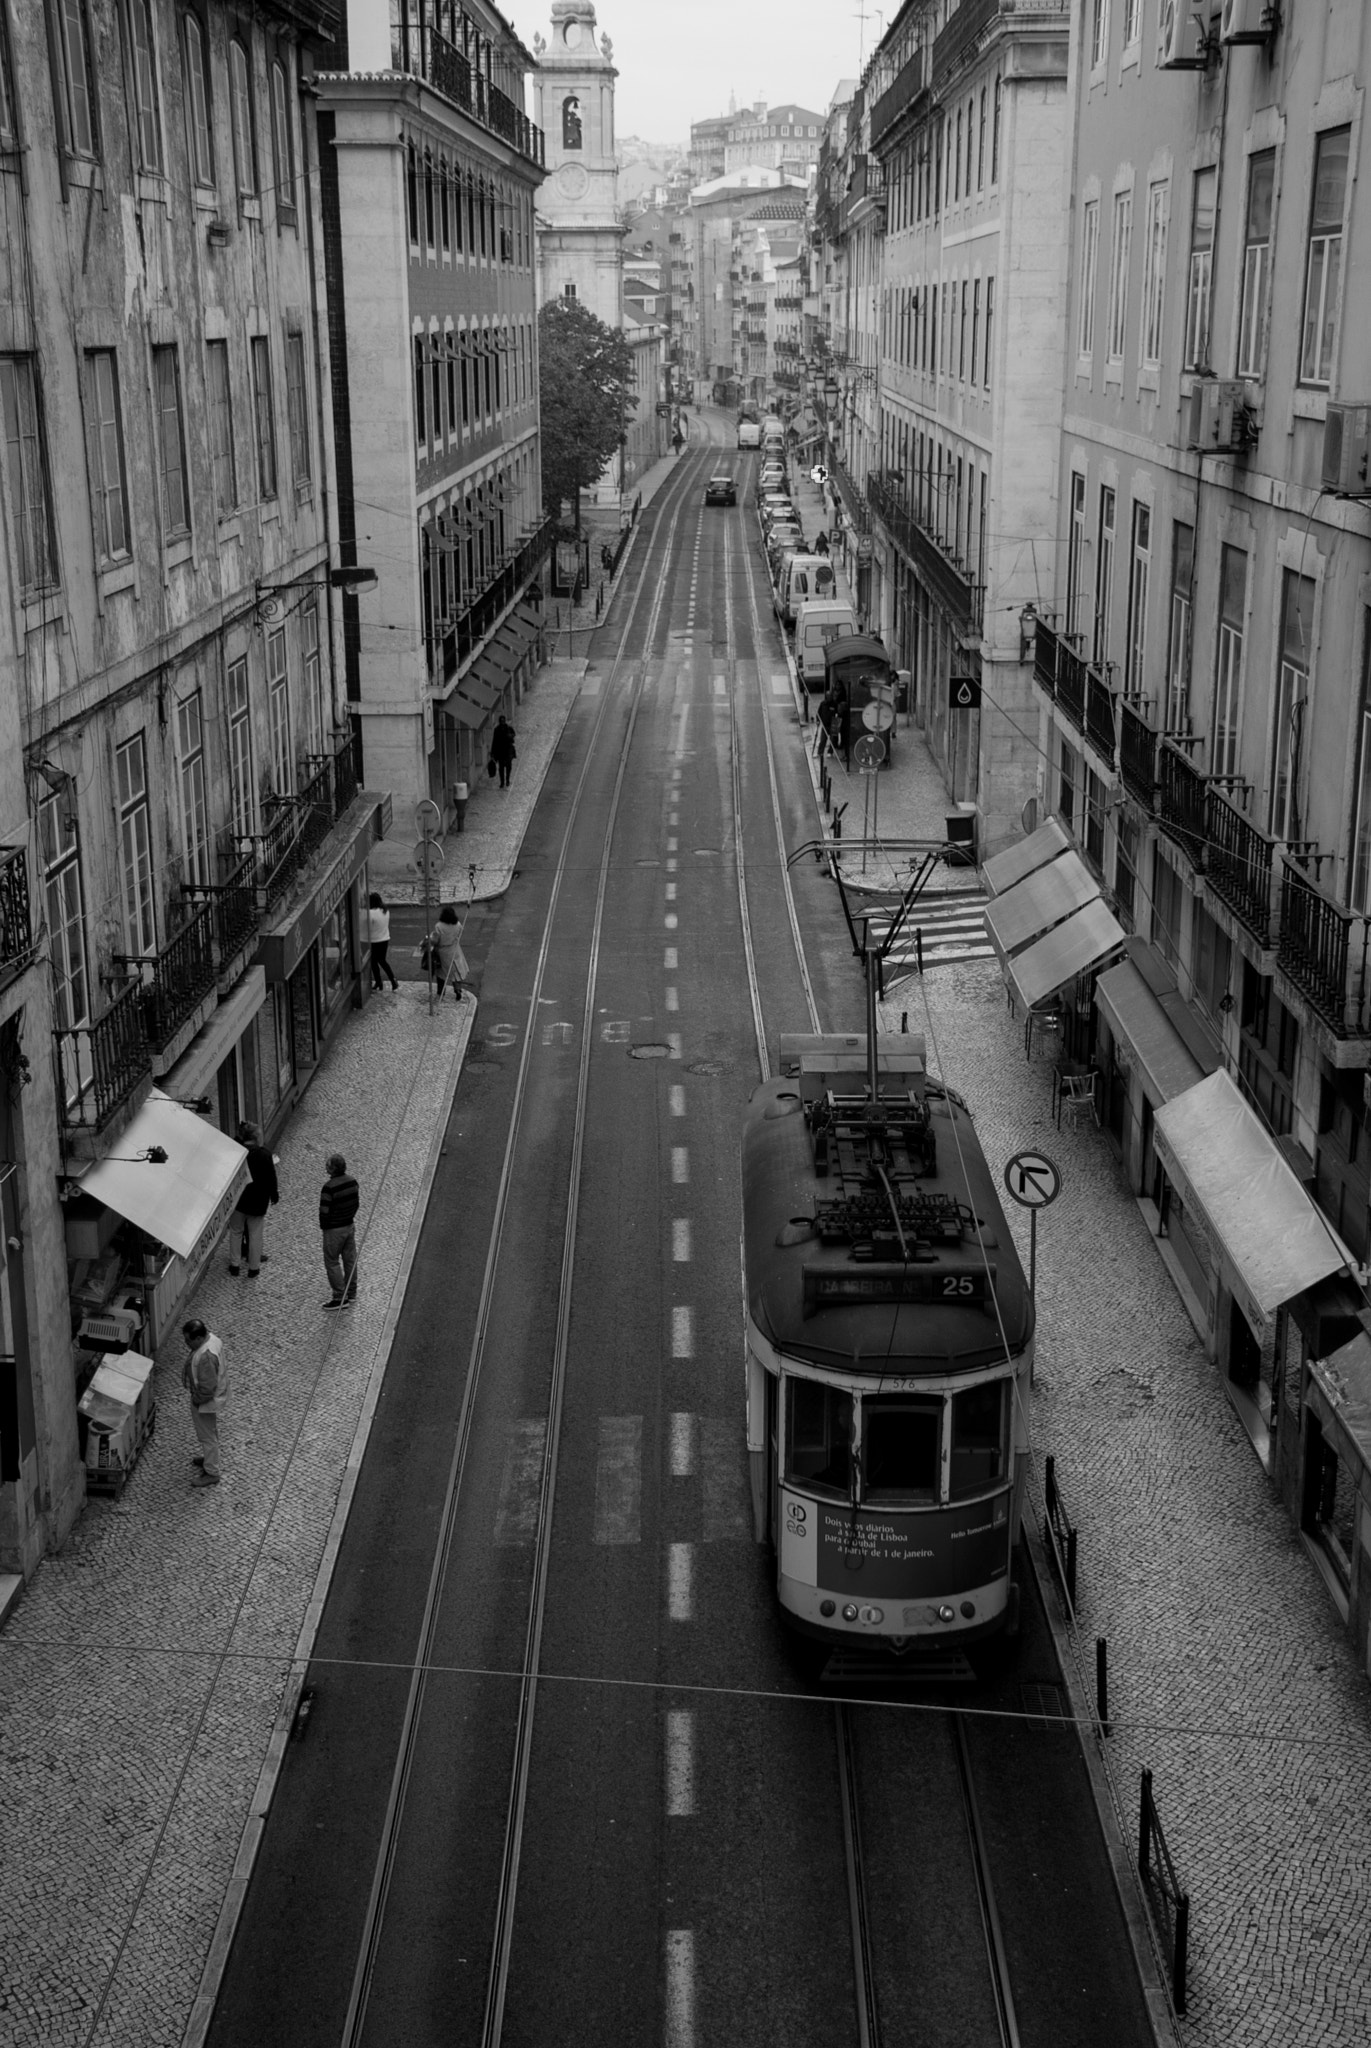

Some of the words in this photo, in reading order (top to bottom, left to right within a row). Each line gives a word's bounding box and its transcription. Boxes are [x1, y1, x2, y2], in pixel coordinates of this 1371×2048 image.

[831, 531, 840, 544] P
[942, 1276, 974, 1296] 25
[893, 1379, 915, 1389] 576
[824, 1515, 842, 1527] Dois
[844, 1520, 864, 1532] vos
[824, 1533, 842, 1544] para
[851, 1539, 876, 1549] Dubai
[844, 1529, 866, 1540] sda
[867, 1532, 878, 1541] de
[880, 1533, 908, 1543] Lisboa
[844, 1547, 868, 1557] partir
[870, 1548, 881, 1557] de
[891, 1549, 902, 1558] de
[903, 1548, 935, 1560] janeiro.
